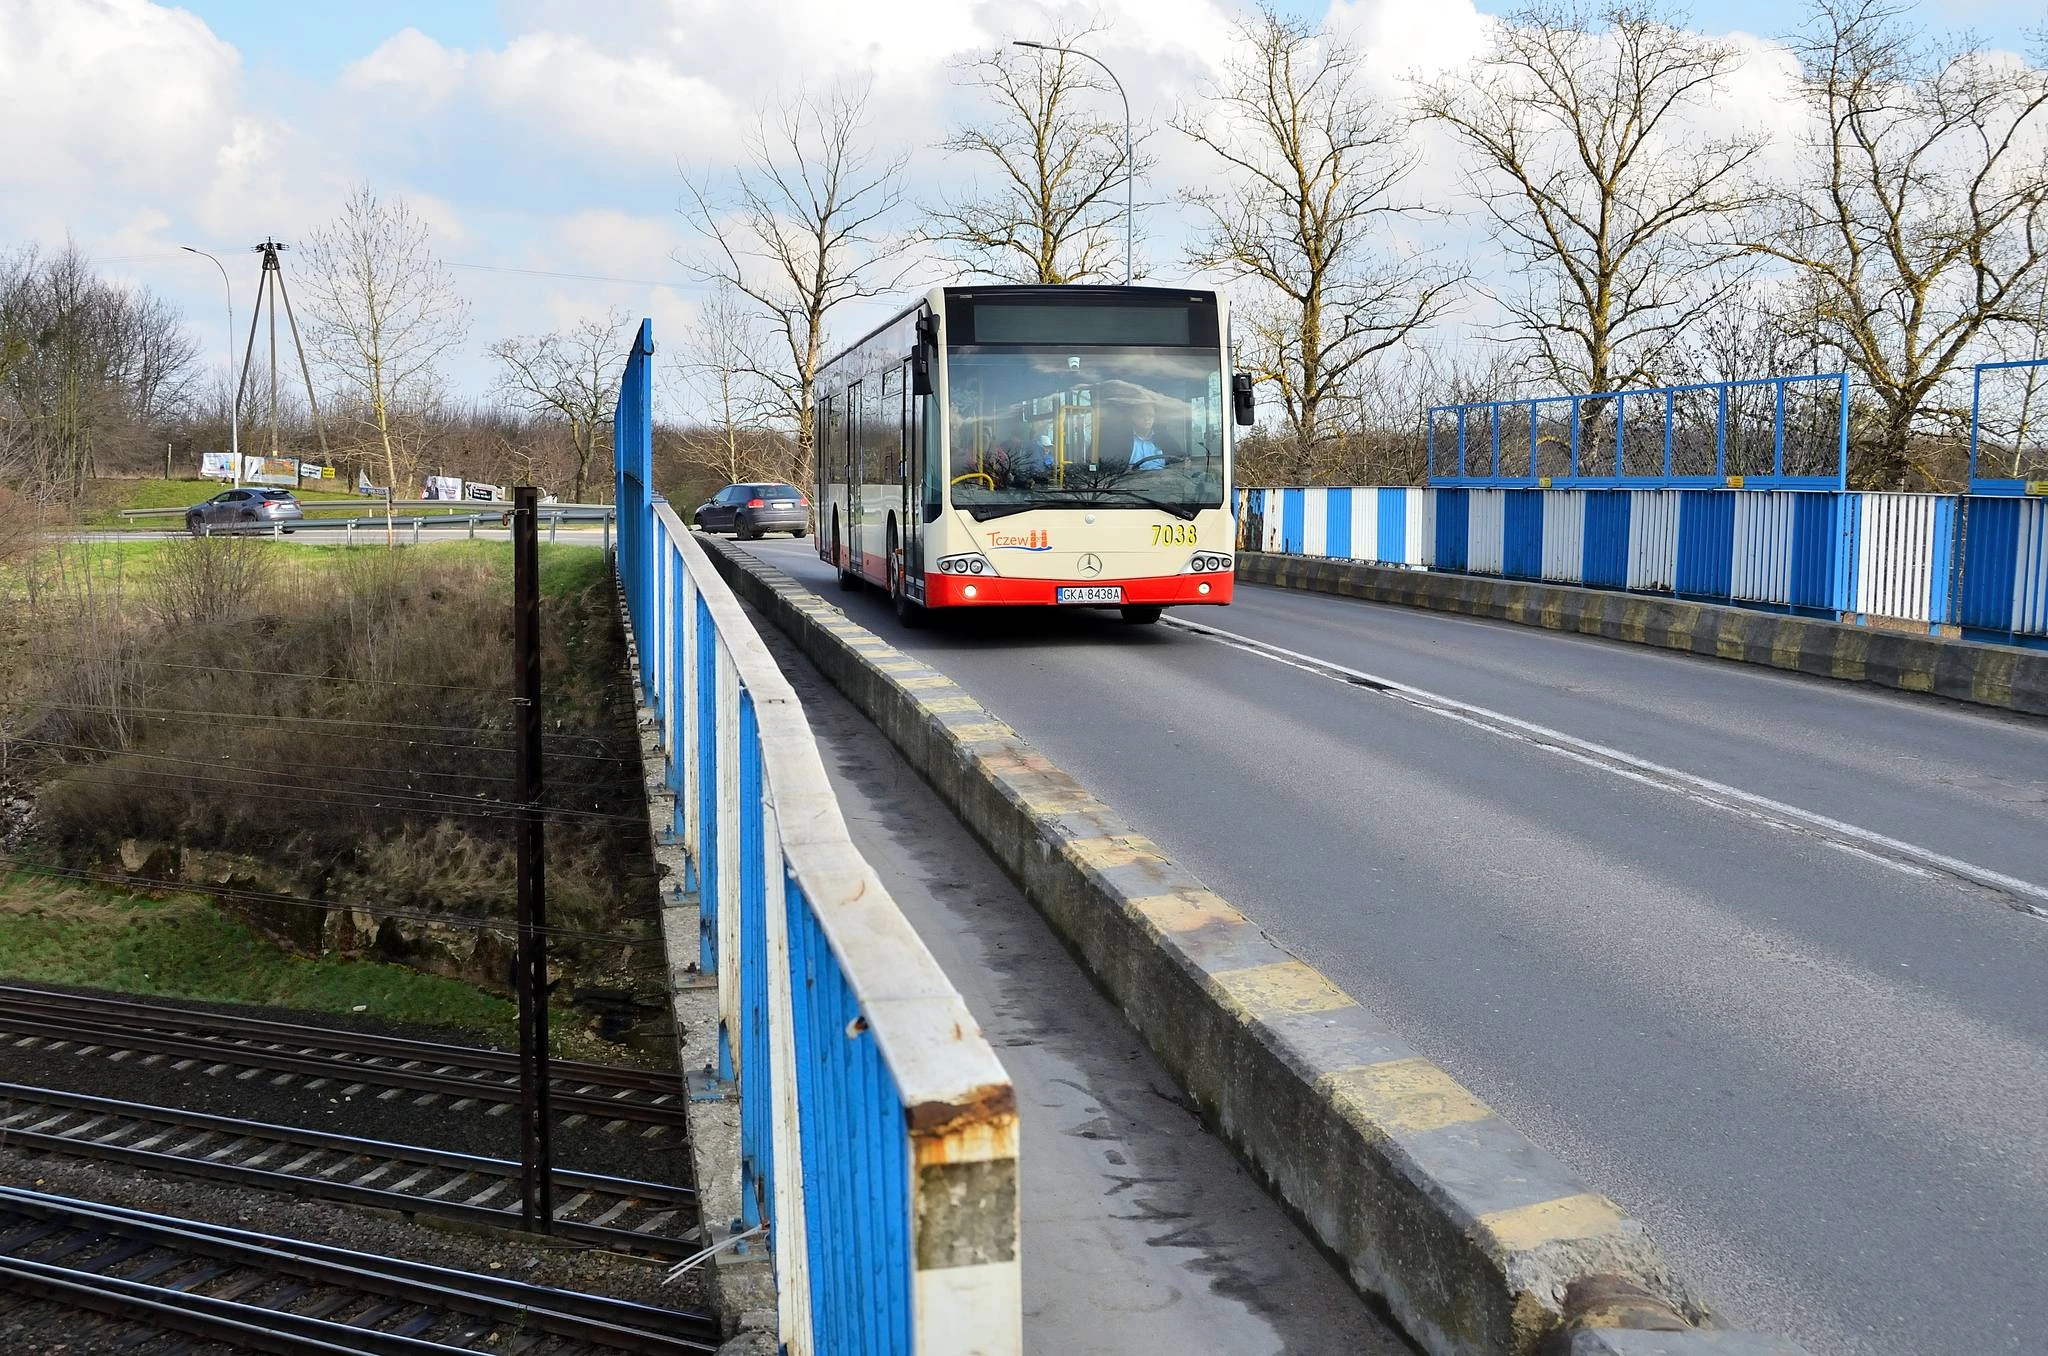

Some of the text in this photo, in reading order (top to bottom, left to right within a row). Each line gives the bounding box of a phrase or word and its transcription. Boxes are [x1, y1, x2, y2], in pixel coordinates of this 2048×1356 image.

[986, 531, 1029, 547] Tczew
[1151, 524, 1197, 547] 7038
[1063, 588, 1120, 601] GKA 8438A
